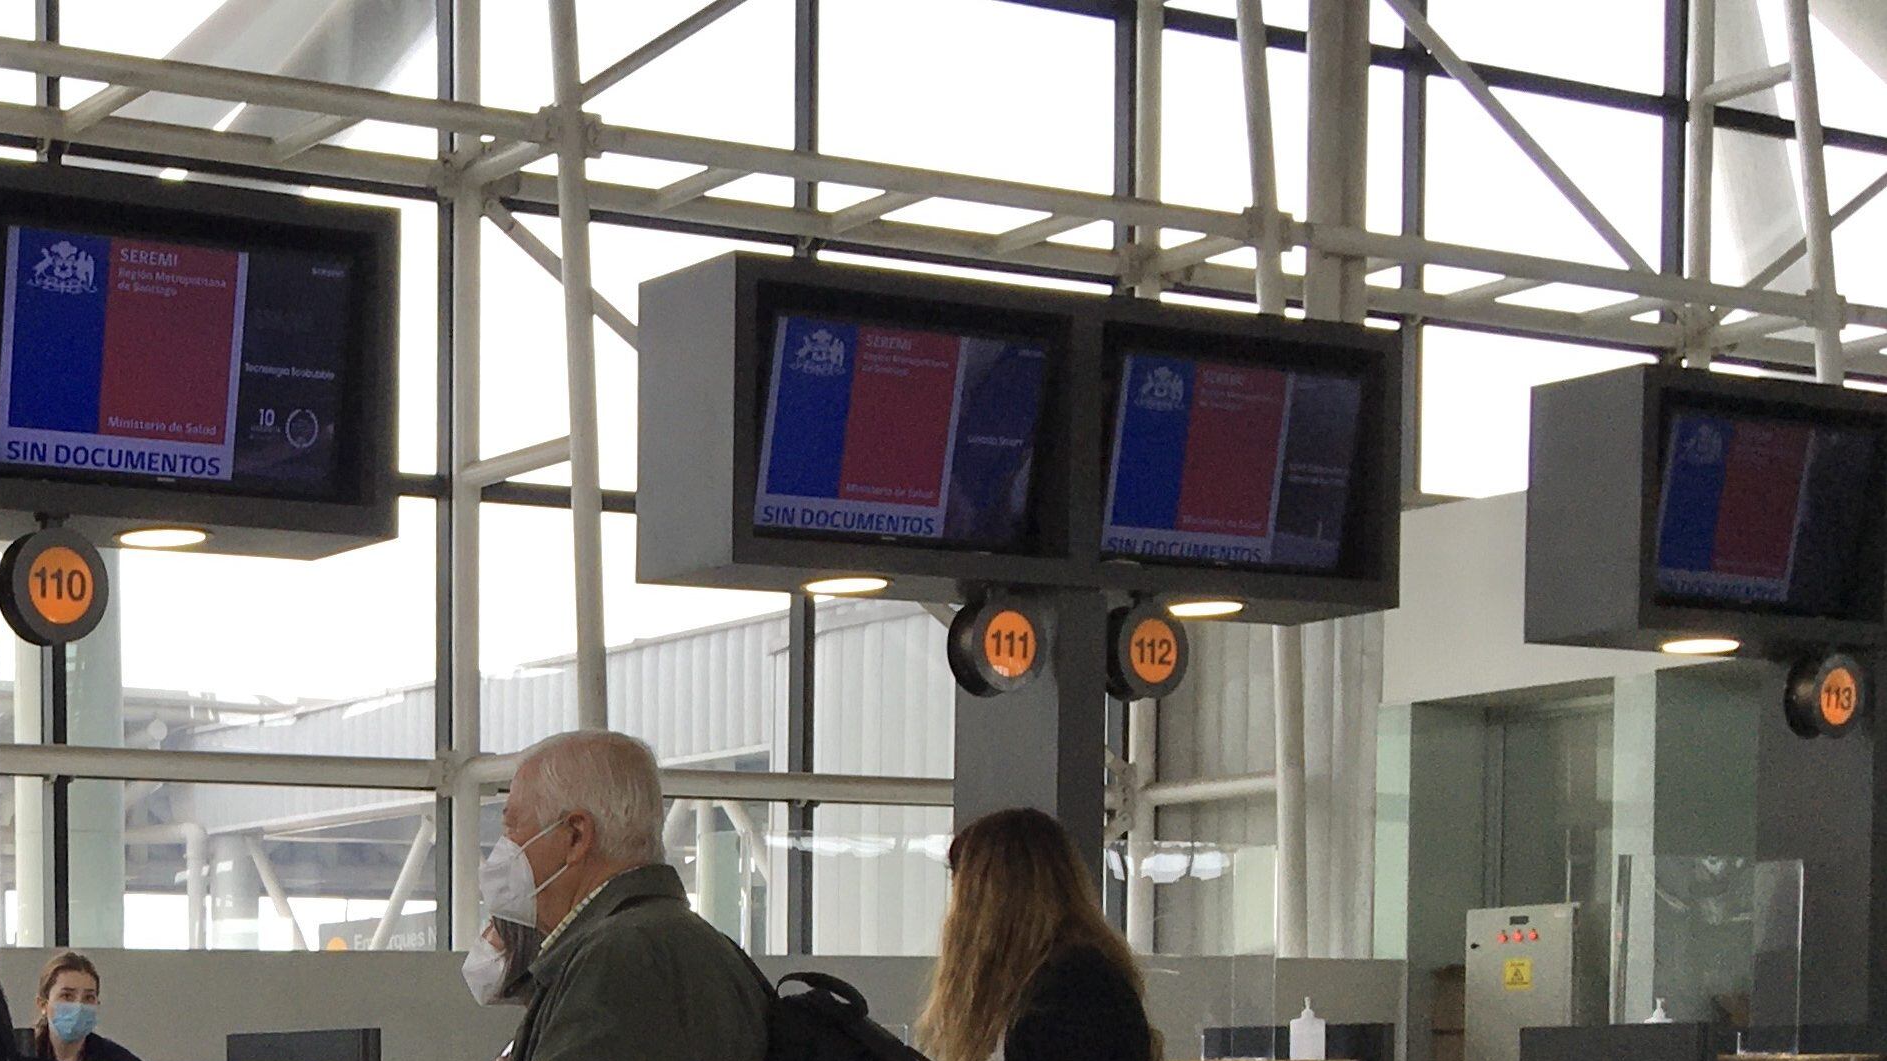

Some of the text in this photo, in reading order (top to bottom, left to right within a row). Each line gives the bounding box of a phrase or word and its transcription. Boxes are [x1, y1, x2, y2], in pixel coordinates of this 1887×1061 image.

[120, 248, 178, 266] SEREMI
[168, 421, 182, 433] de
[6, 440, 221, 476] SIN DOCUMENTOS
[762, 505, 935, 535] SIN DOCUMENTOS
[34, 566, 87, 602] 110
[991, 629, 1029, 659] 111
[1134, 638, 1173, 666] 112
[1824, 686, 1852, 710] 113
